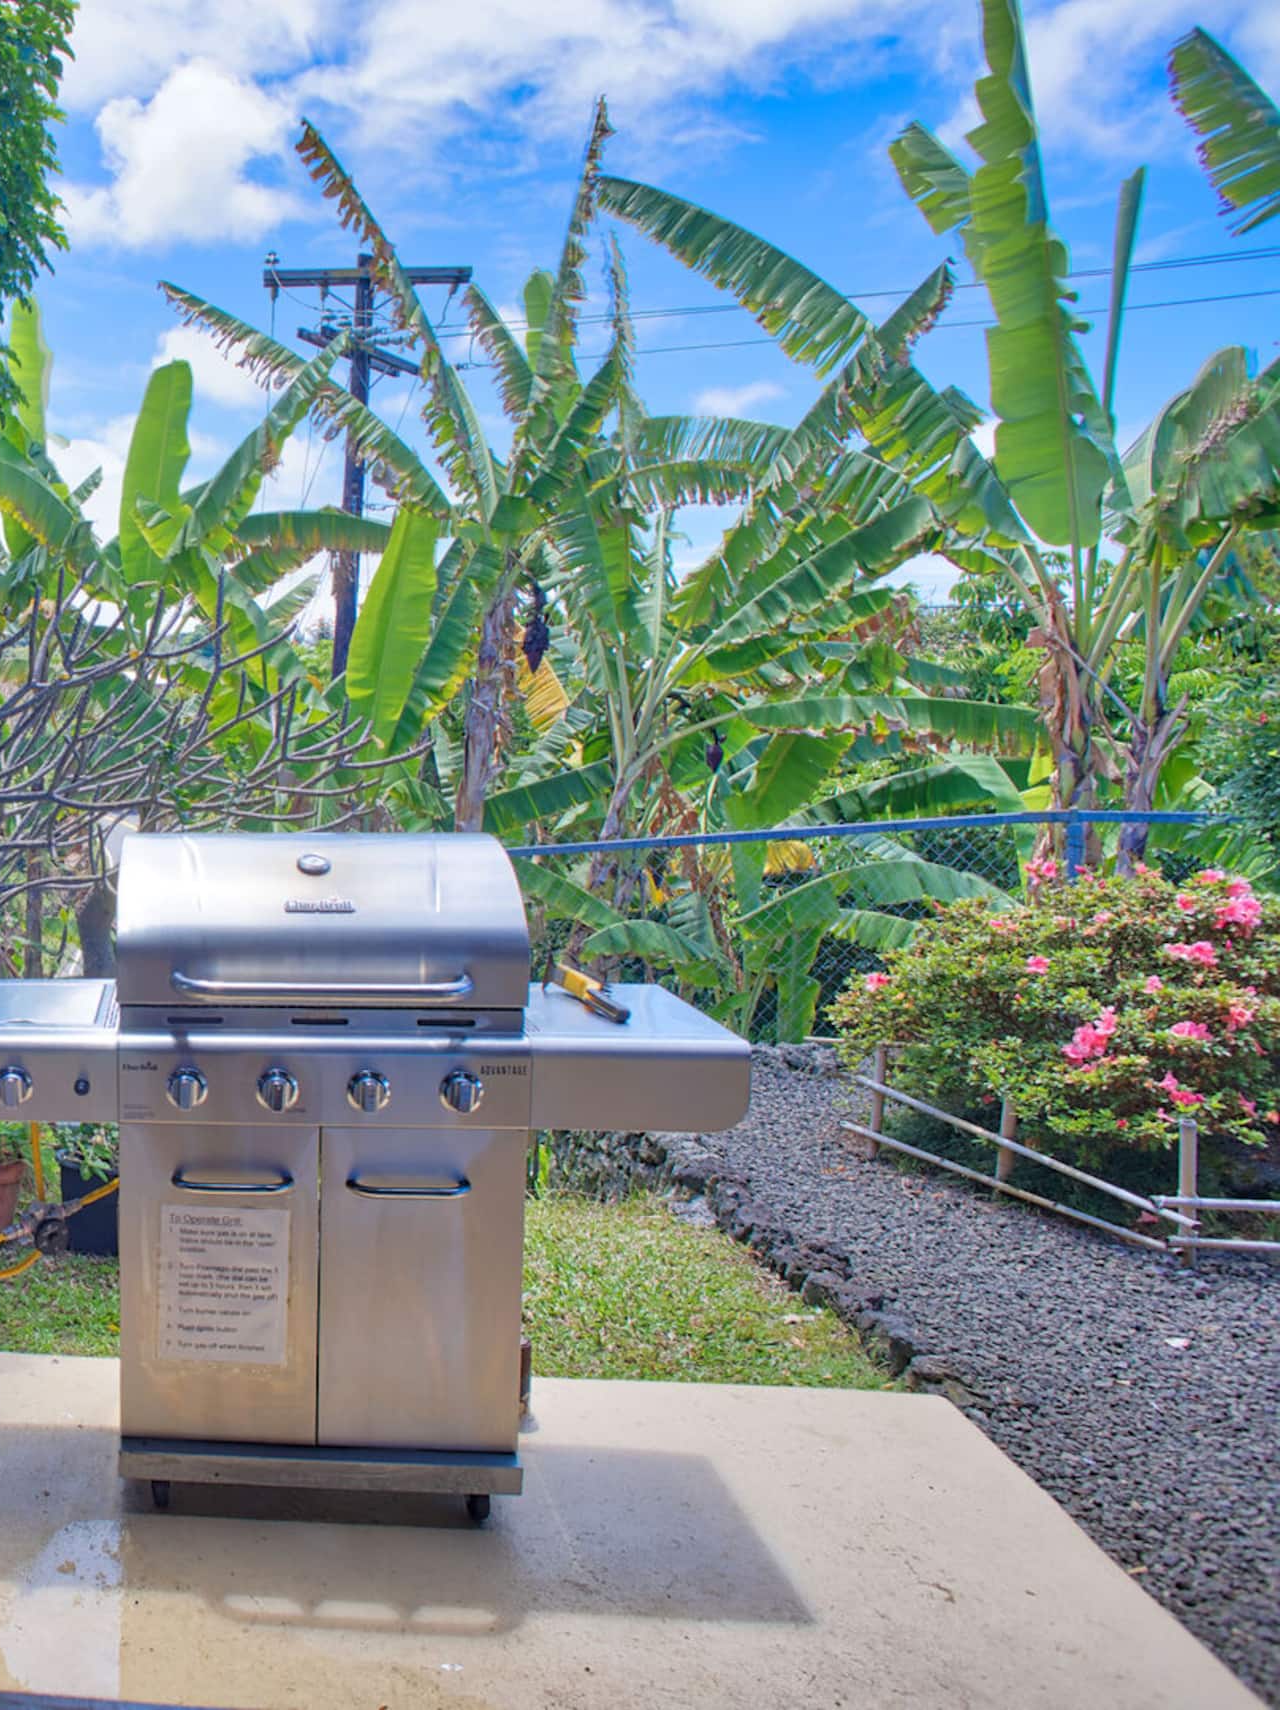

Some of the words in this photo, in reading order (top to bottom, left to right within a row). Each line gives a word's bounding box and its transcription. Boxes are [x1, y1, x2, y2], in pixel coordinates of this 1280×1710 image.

[480, 1065, 527, 1076] ADVANTAGE
[169, 1213, 180, 1225] To
[183, 1214, 220, 1226] Operate
